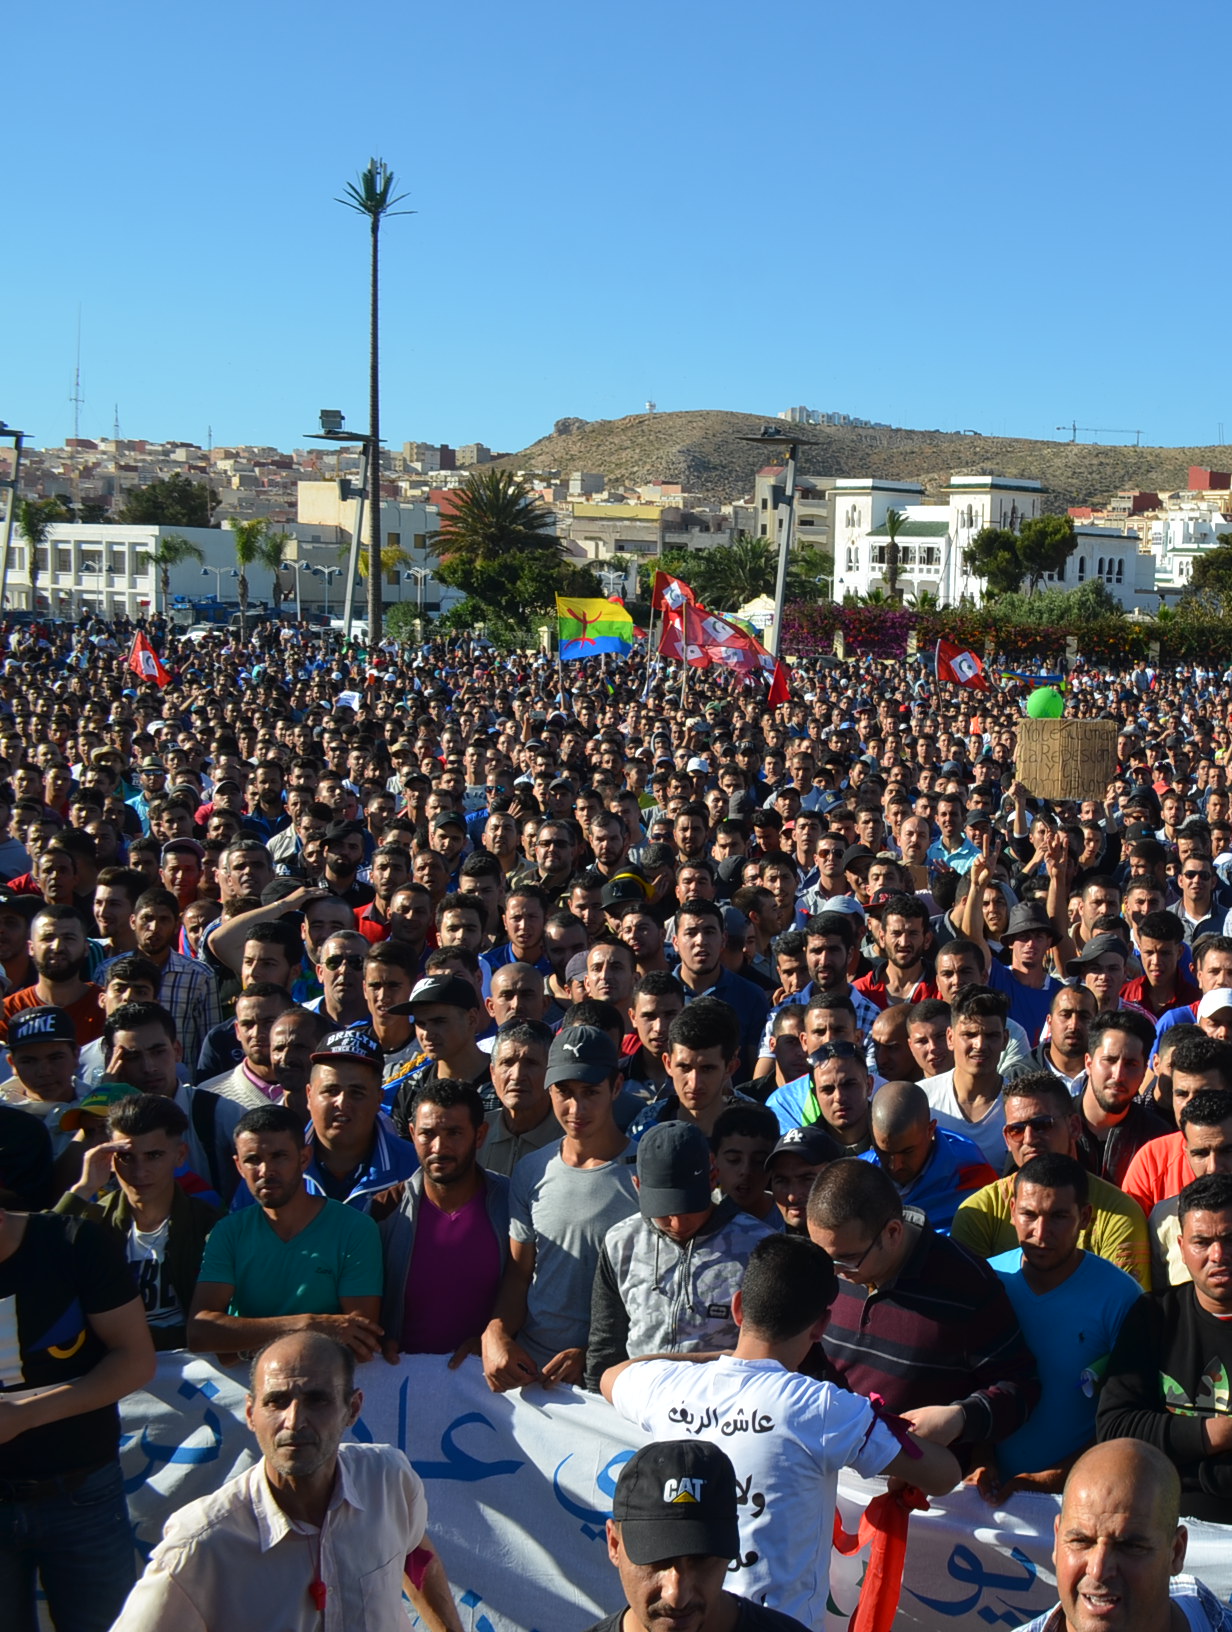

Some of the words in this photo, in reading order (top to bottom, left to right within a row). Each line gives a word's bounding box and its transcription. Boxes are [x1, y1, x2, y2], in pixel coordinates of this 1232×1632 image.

[17, 1014, 57, 1038] NIKE
[668, 1400, 719, 1435] الريف
[720, 1408, 776, 1437] عاش
[663, 1477, 704, 1503] CAT
